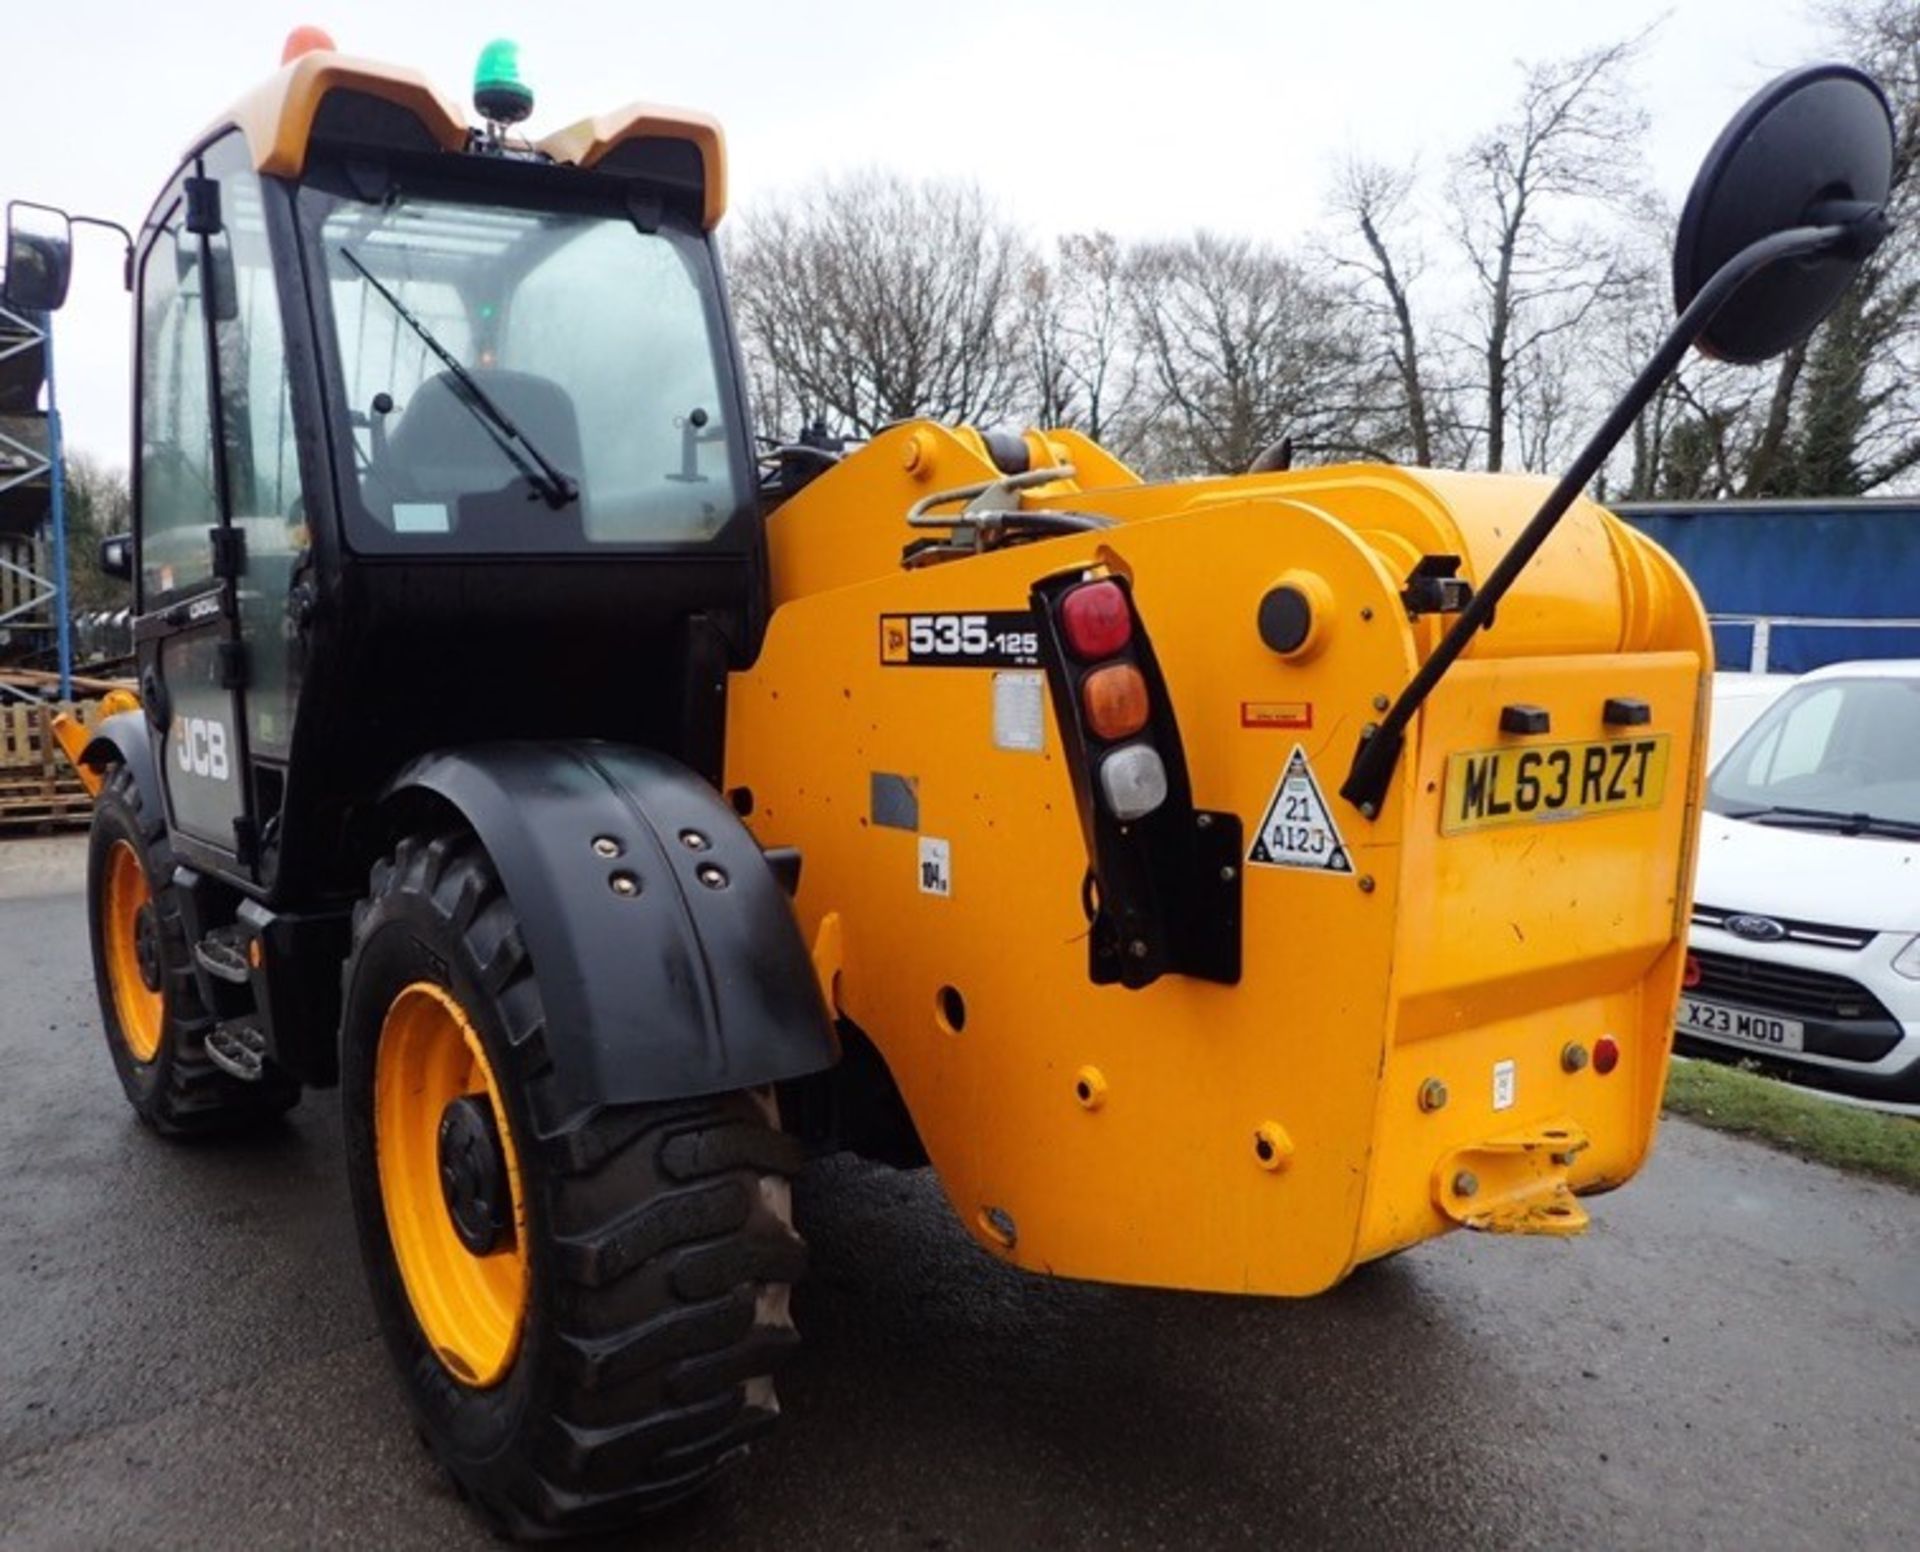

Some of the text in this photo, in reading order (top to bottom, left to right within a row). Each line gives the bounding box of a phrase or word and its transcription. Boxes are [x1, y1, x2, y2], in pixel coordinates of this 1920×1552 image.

[910, 615, 1038, 655] 535-125
[177, 717, 229, 781] JCB
[1461, 741, 1656, 820] ML63 RZT
[1285, 796, 1312, 822] 21
[1688, 1003, 1784, 1043] X23 MOD
